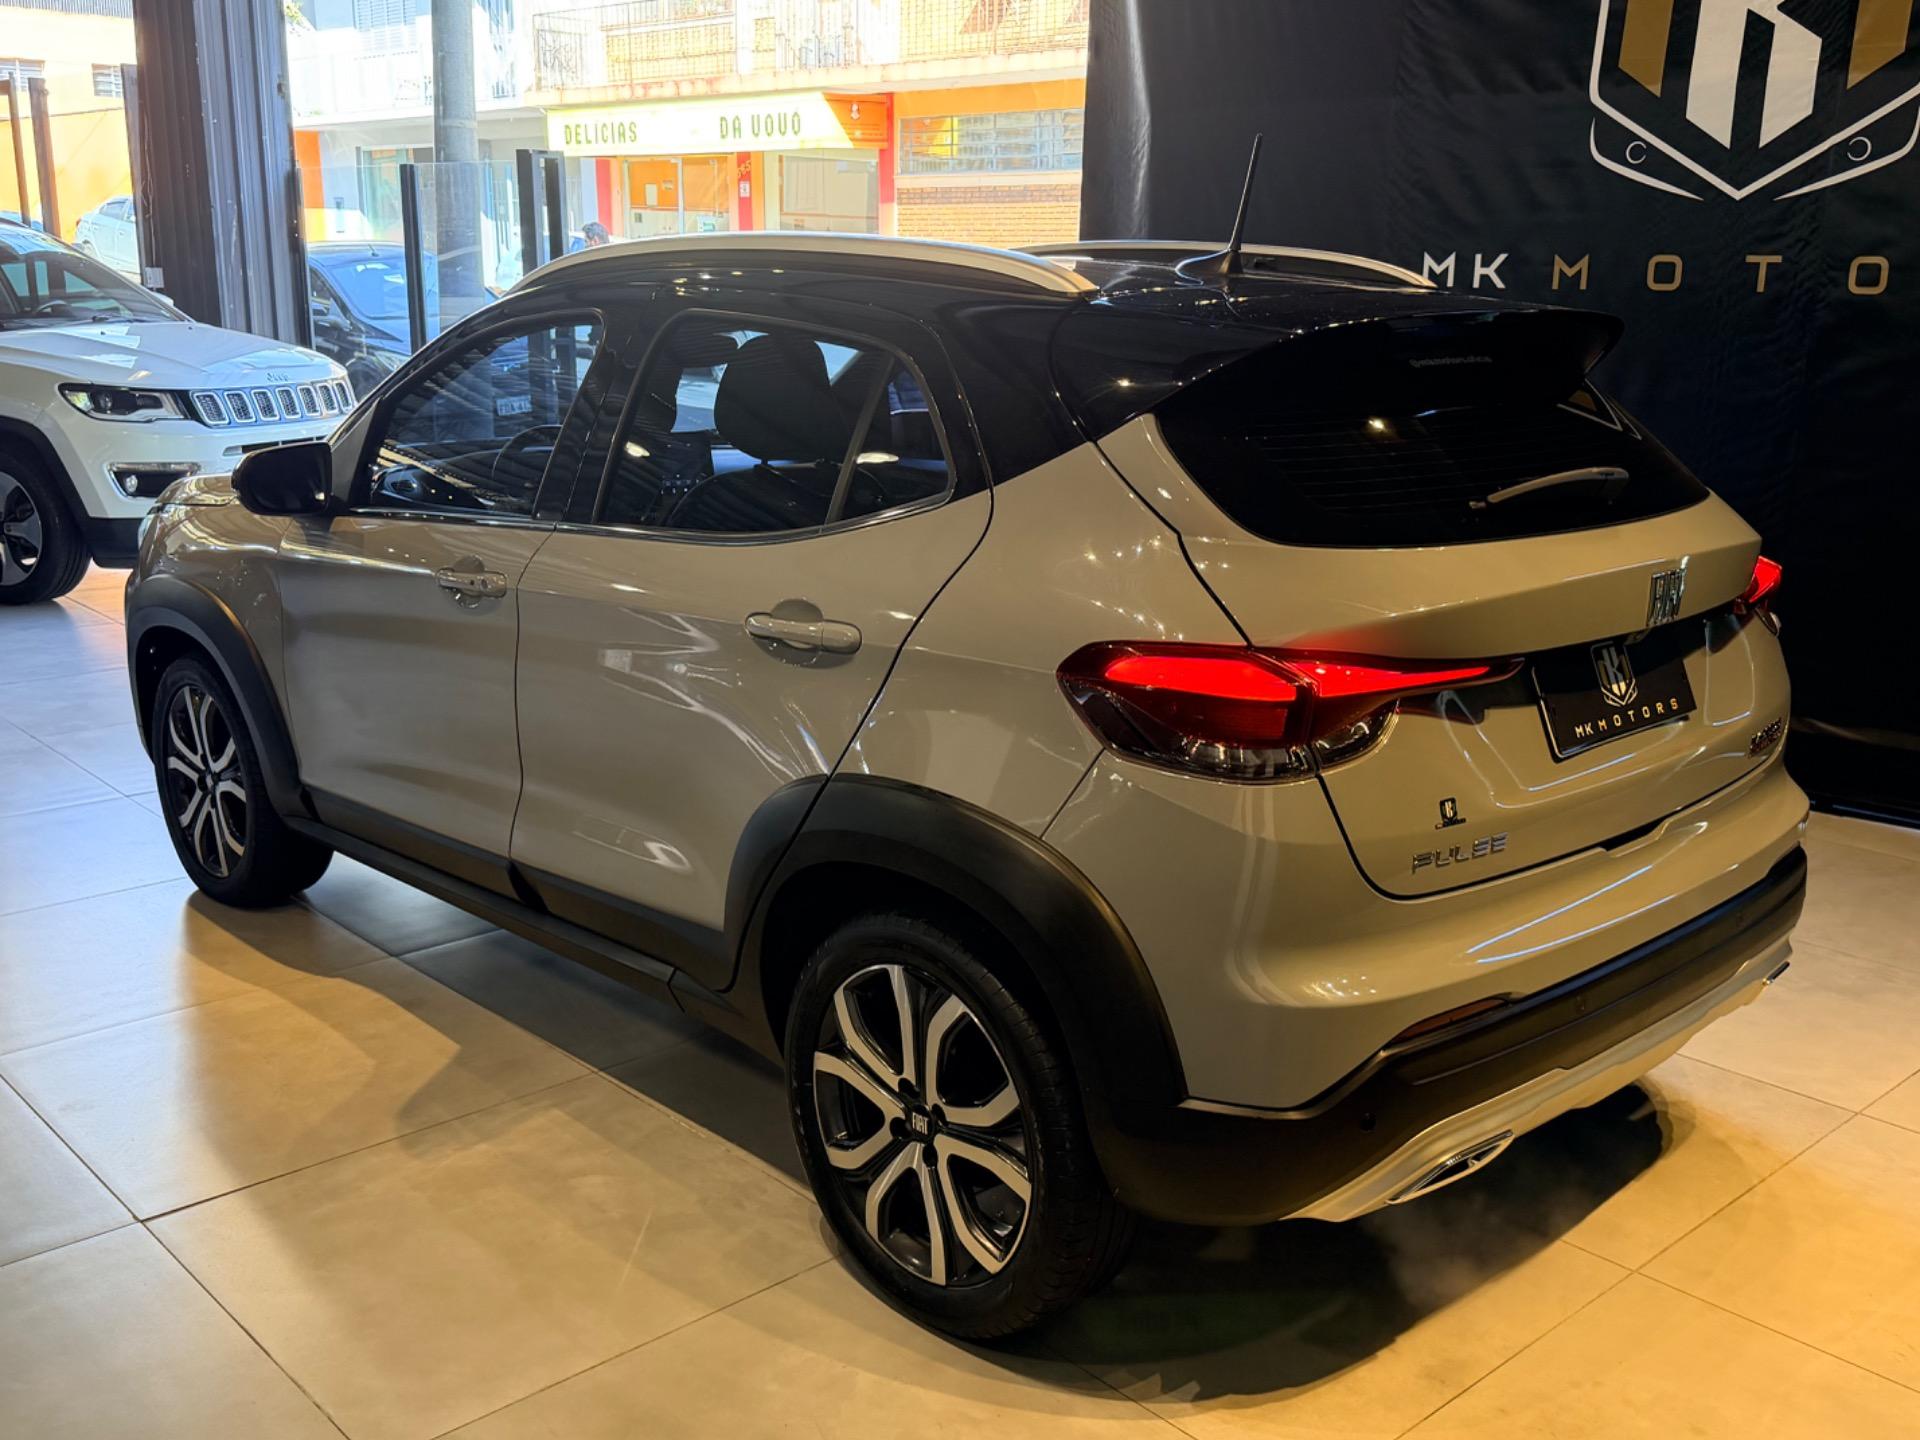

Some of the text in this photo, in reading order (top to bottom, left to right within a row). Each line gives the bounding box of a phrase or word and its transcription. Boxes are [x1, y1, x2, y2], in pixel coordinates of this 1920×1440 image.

[564, 121, 637, 145] DELICIAS
[720, 115, 741, 139] DA
[1422, 252, 1507, 288] MK
[1574, 698, 1679, 738] MK MOTORS
